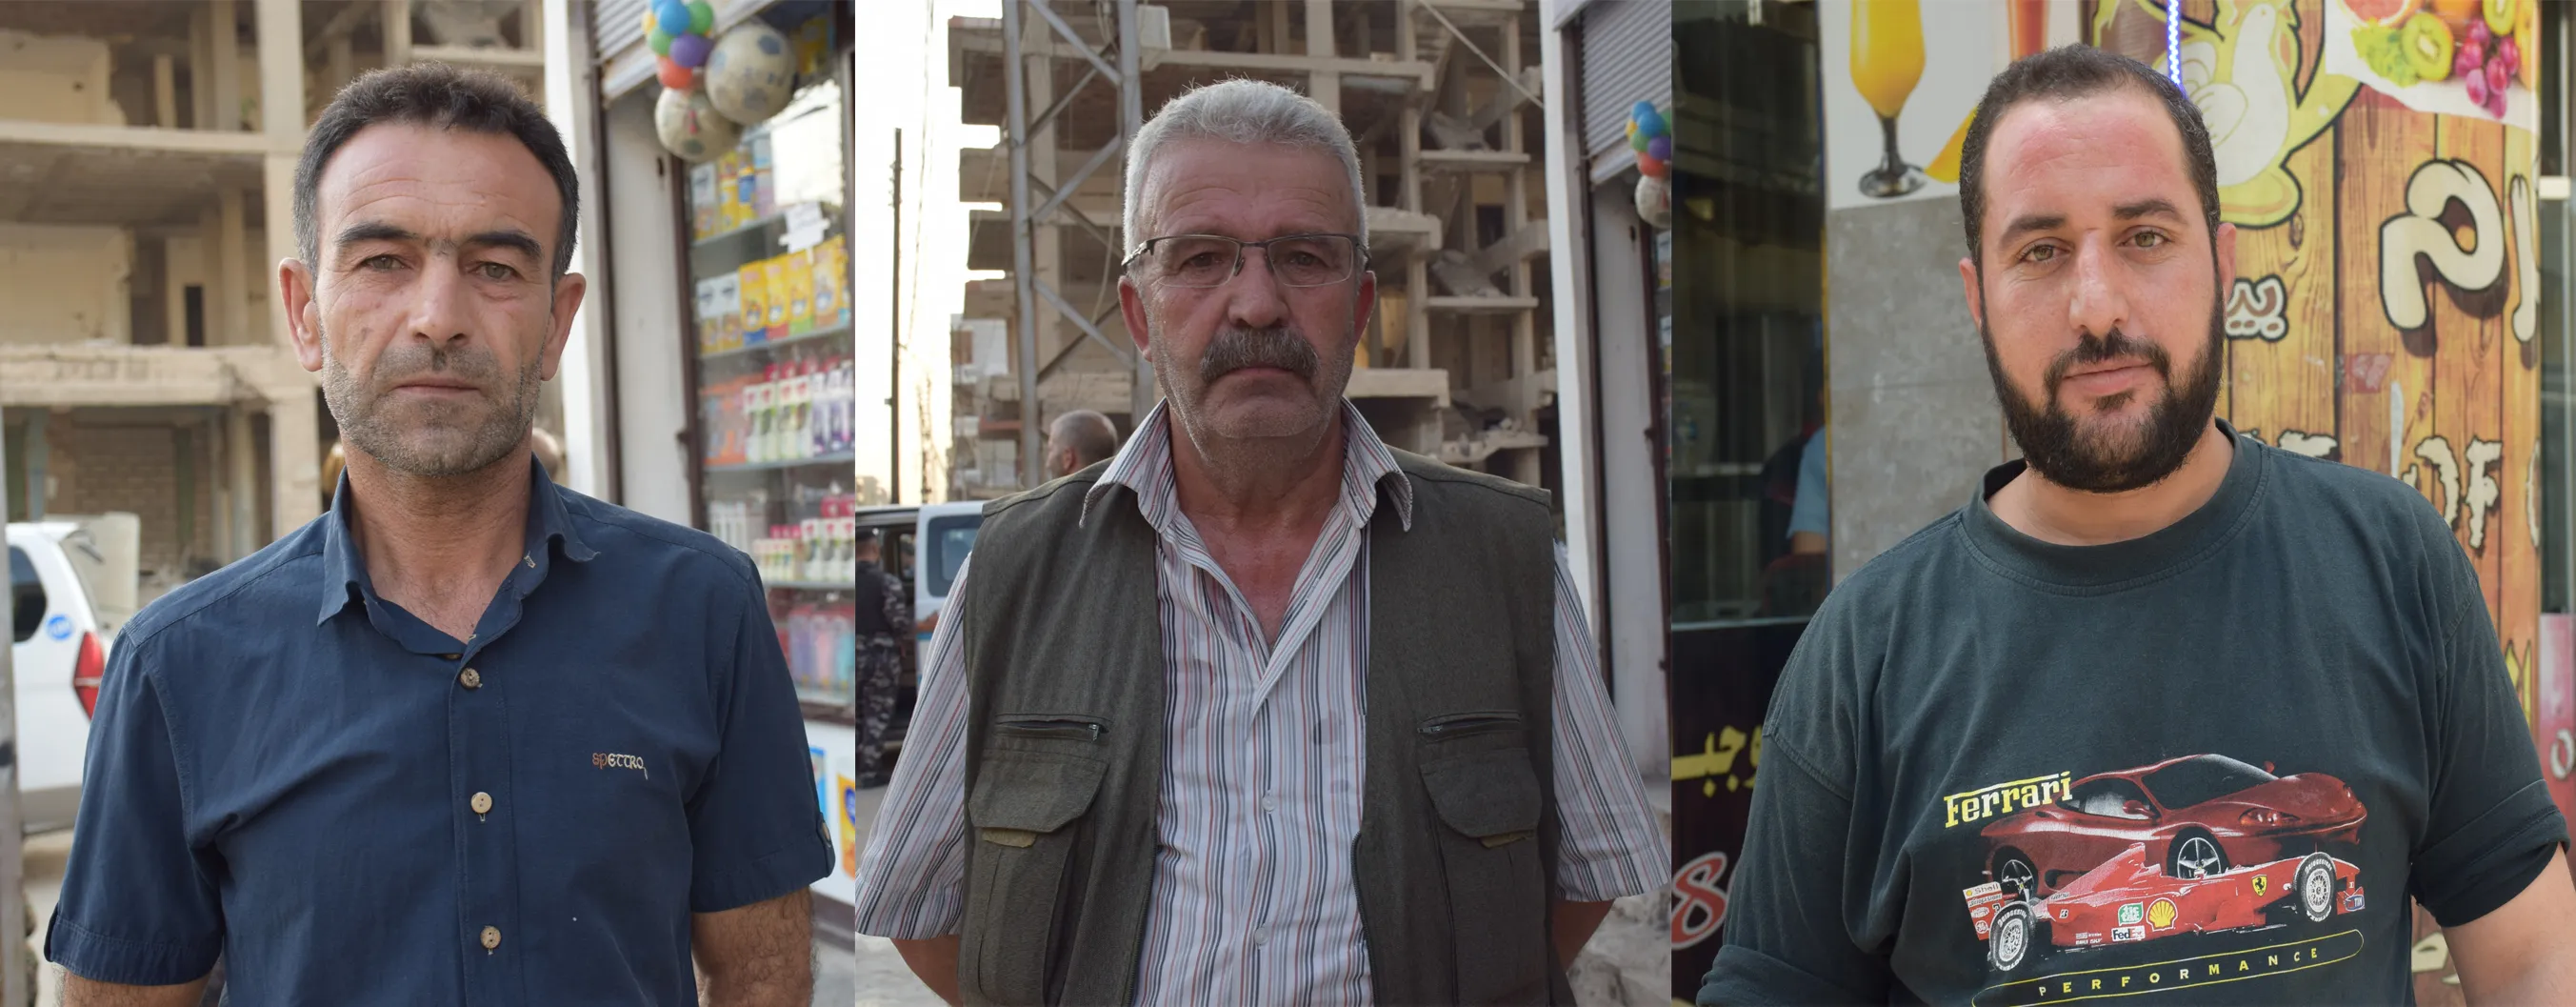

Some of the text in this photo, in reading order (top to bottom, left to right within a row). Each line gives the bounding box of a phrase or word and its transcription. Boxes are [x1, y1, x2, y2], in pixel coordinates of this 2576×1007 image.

[1944, 770, 2073, 829] Ferrari
[1671, 852, 1735, 950] 8
[2112, 927, 2145, 940] FedEx
[2039, 947, 2318, 997] PERFORMANCE
